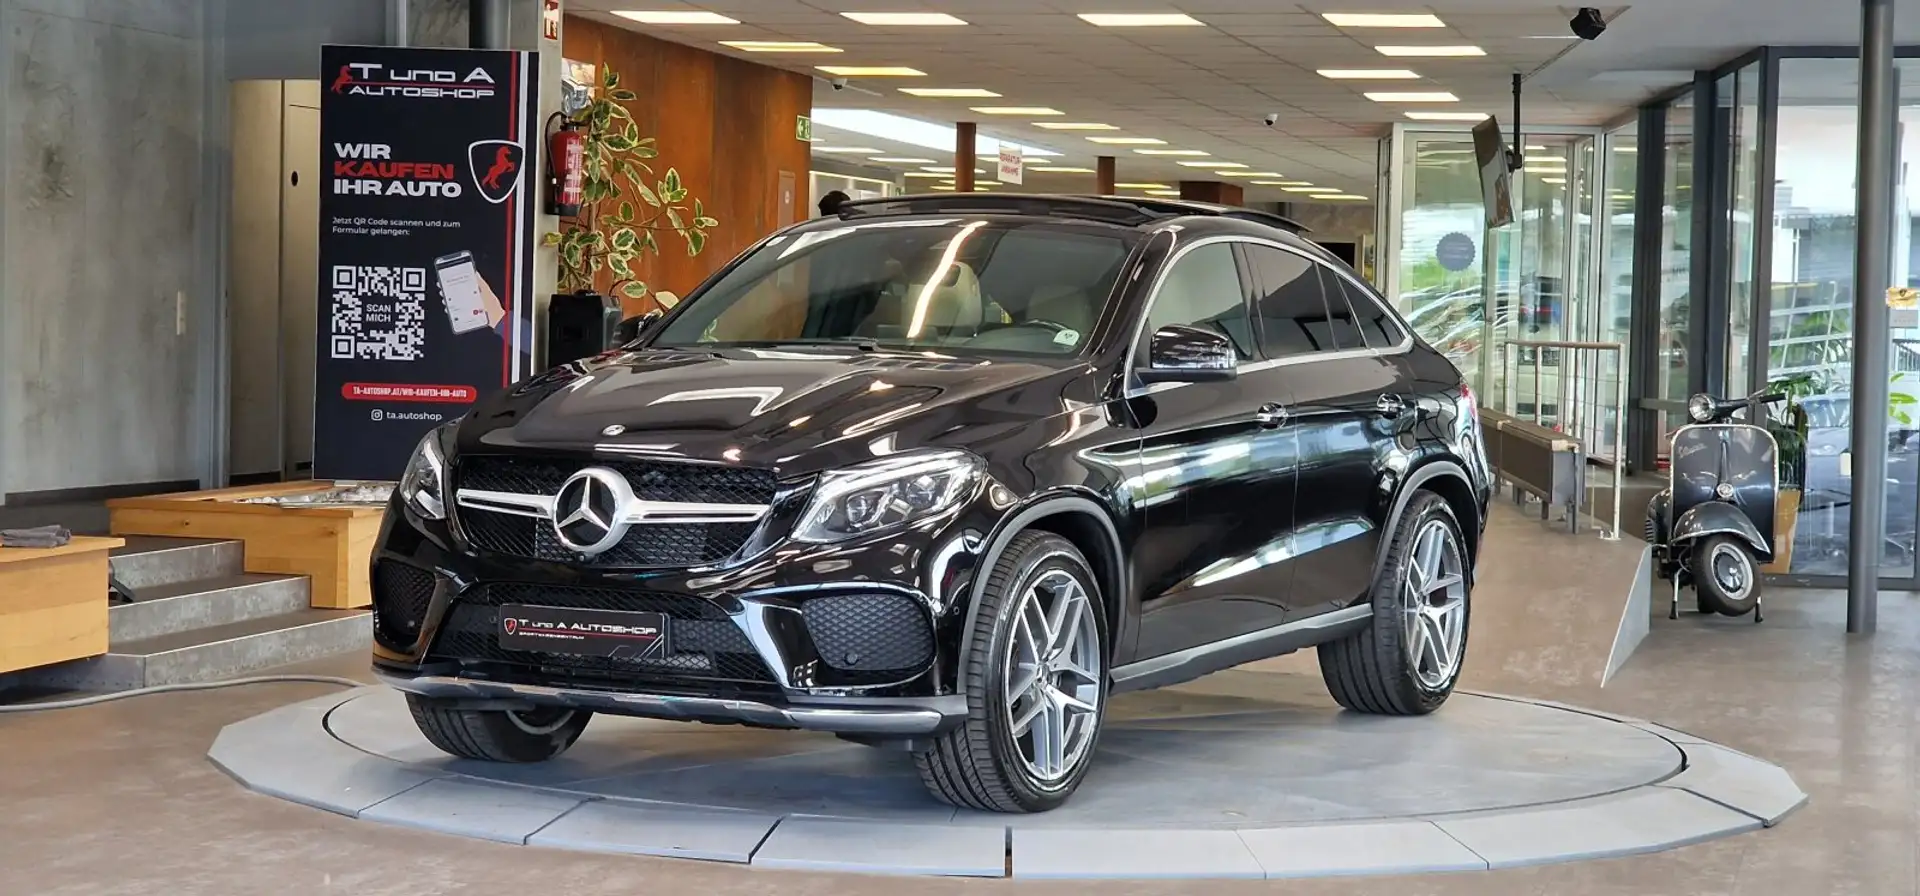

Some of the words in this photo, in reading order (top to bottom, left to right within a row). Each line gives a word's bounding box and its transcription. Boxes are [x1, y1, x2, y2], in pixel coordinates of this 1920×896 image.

[350, 63, 382, 79] T
[463, 67, 496, 84] A
[348, 85, 495, 99] AUTOSHOP
[333, 142, 391, 159] WIR
[334, 161, 454, 179] KAUFEN
[333, 179, 382, 195] IHR
[385, 180, 462, 198] AUTO
[332, 217, 352, 225] Jetzt
[353, 217, 366, 226] QR
[367, 218, 388, 226] Code
[389, 219, 424, 227] scannen
[425, 219, 441, 227] und
[332, 225, 369, 234] Formular
[366, 303, 392, 313] SCAN
[366, 313, 392, 323] MICH
[386, 411, 443, 422] ta.autoshop
[518, 619, 529, 627] T
[571, 622, 657, 635] AUTOSHOP
